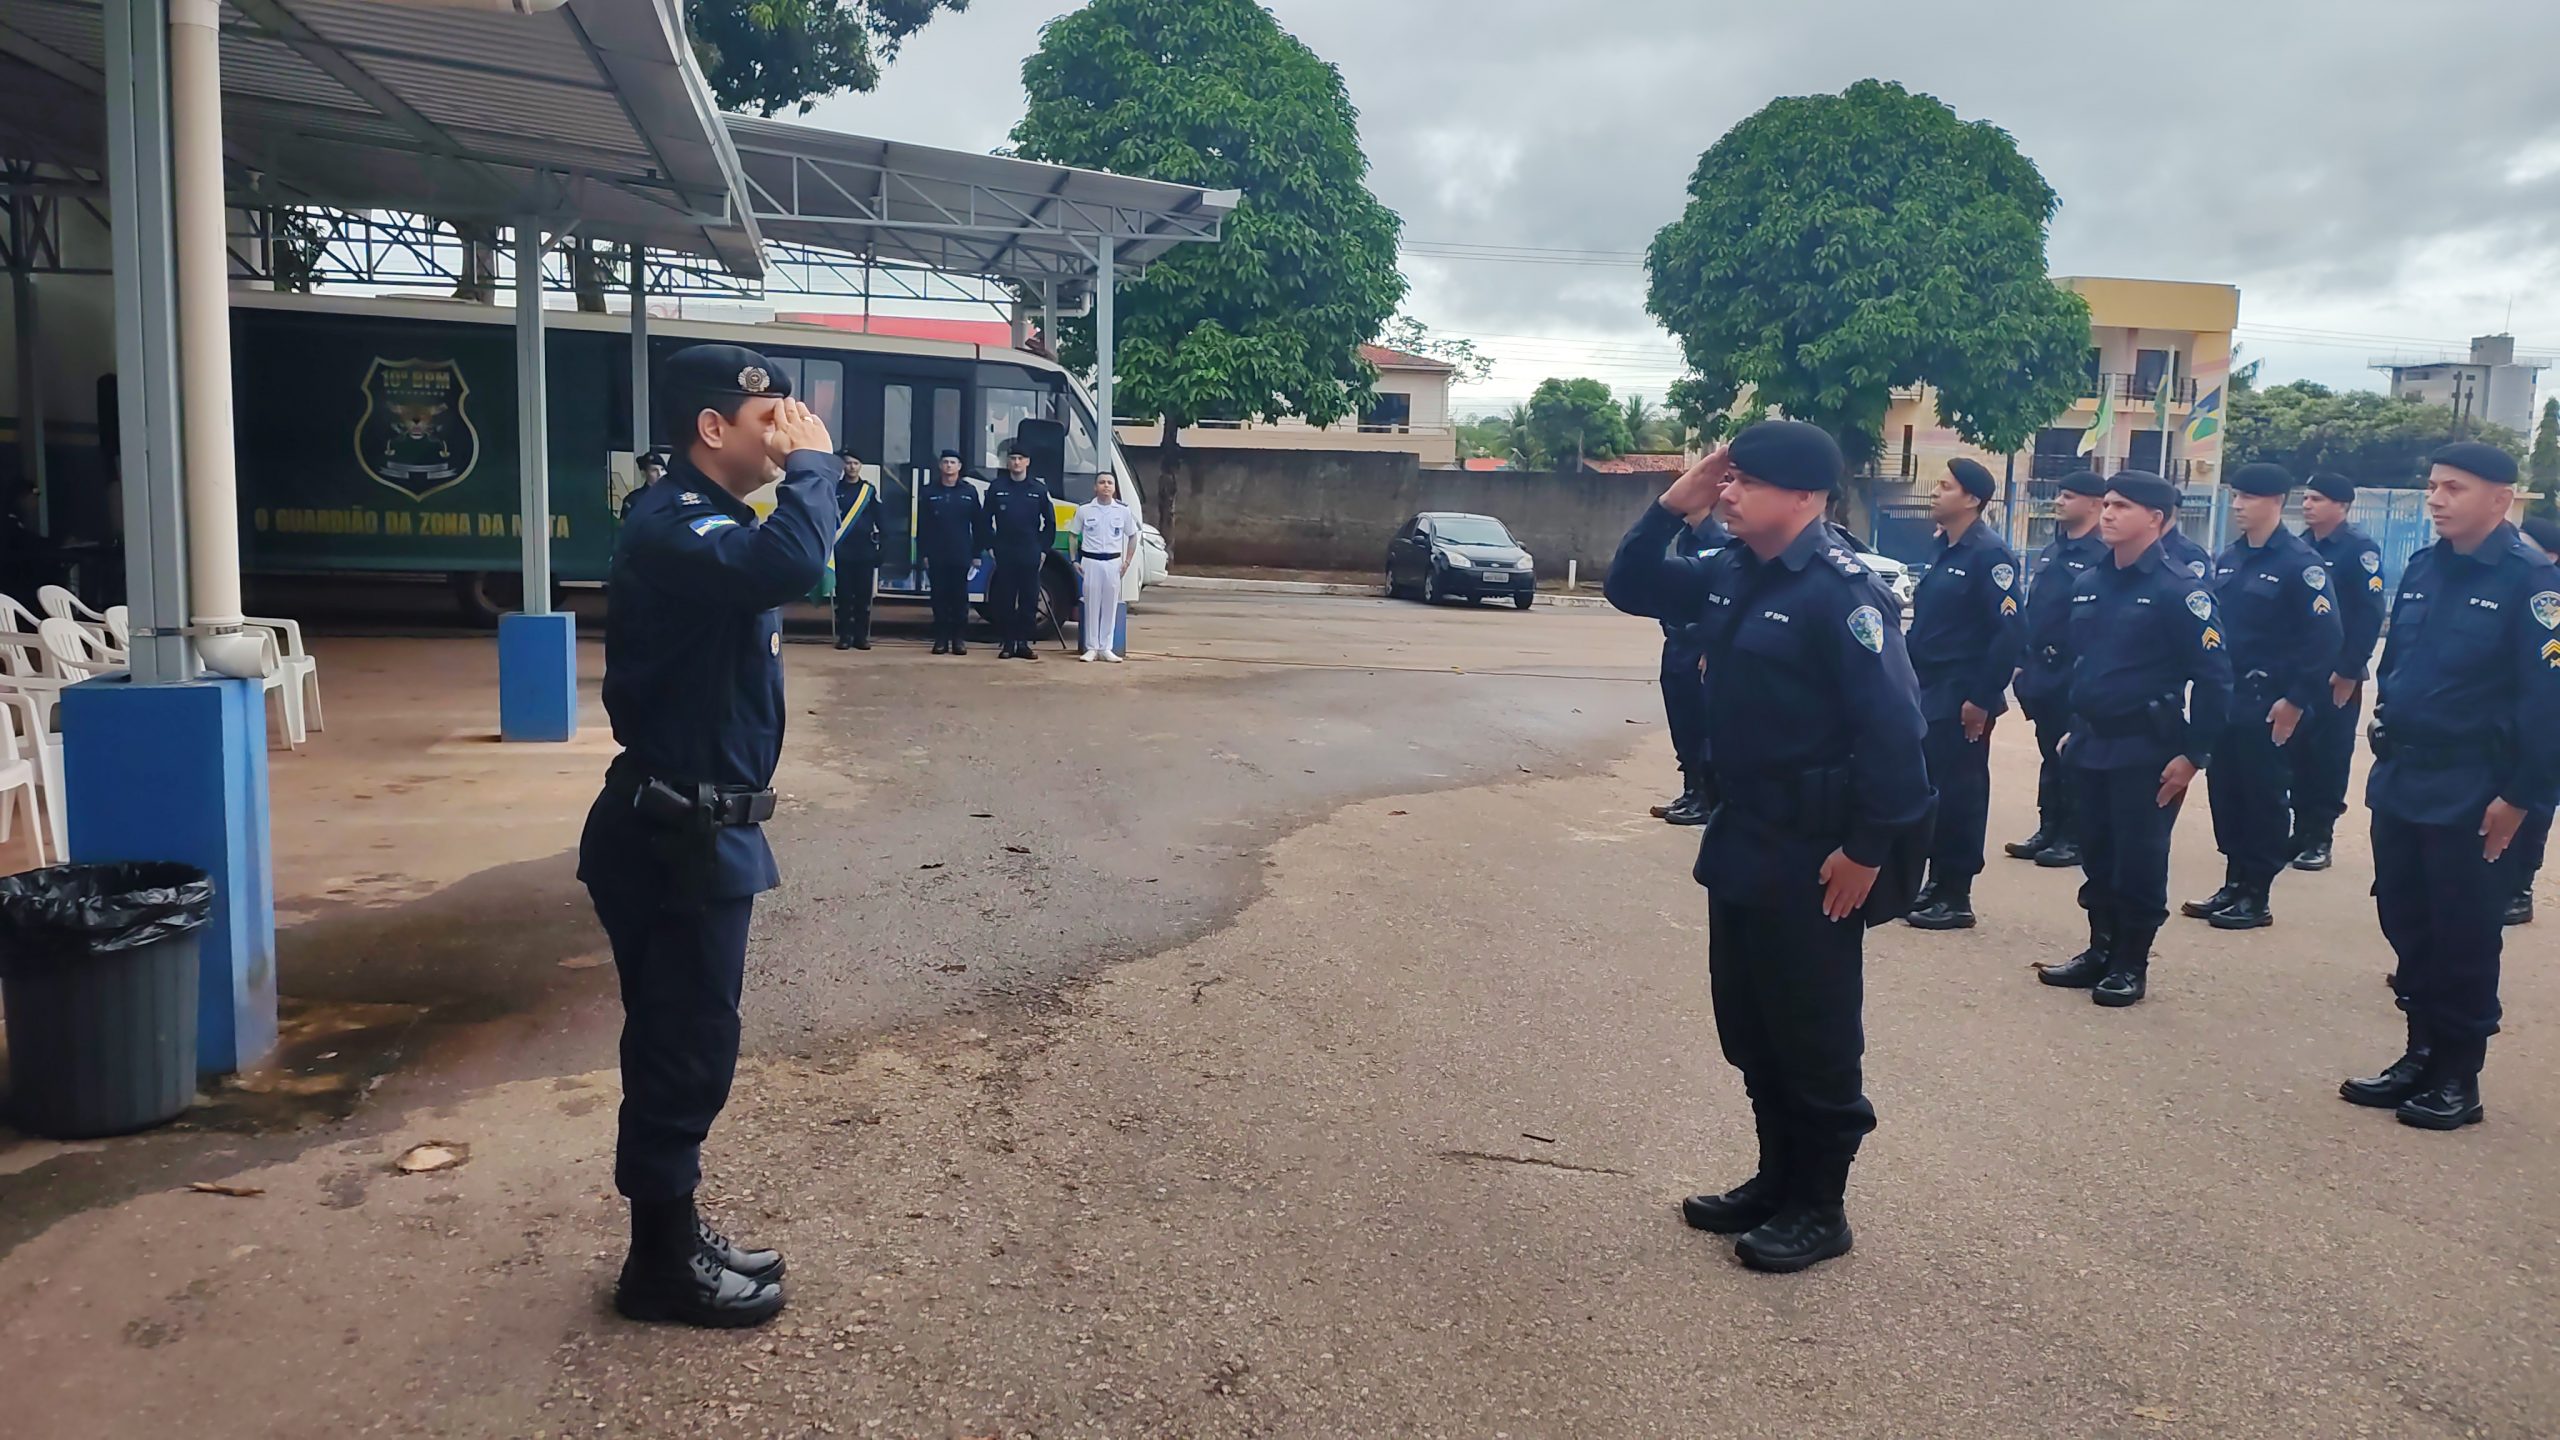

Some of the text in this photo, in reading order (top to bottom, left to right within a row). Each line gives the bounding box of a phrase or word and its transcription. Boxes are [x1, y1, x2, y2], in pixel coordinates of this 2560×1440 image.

[412, 371, 451, 390] BPM
[254, 508, 269, 532] O
[275, 505, 379, 534] GUARDIÃO
[384, 511, 412, 535] DA
[419, 512, 471, 536] ZONA
[478, 513, 505, 537] DA
